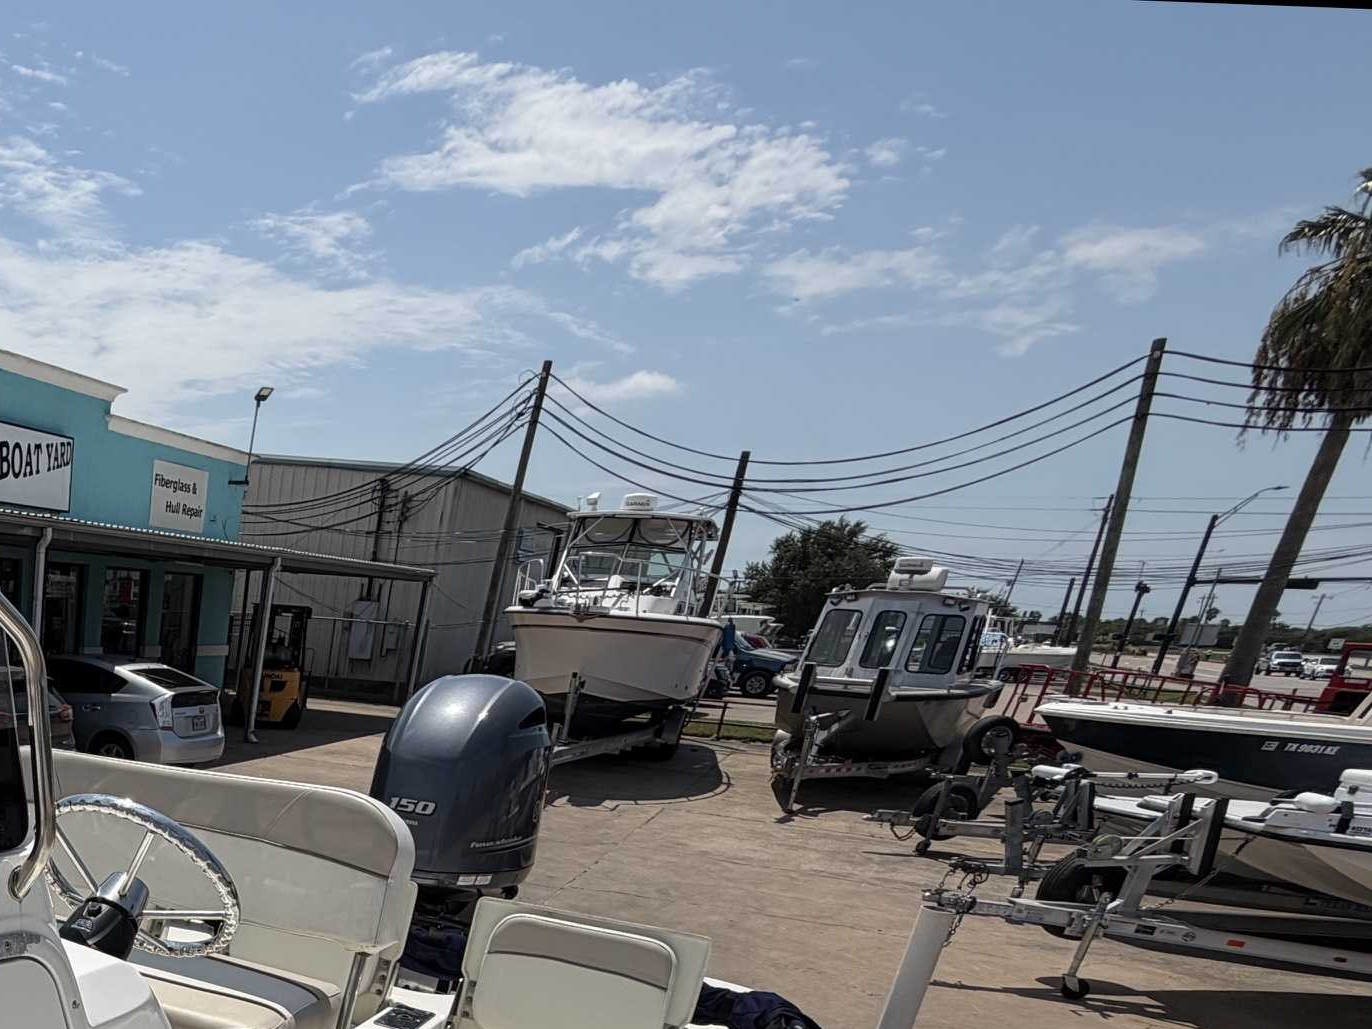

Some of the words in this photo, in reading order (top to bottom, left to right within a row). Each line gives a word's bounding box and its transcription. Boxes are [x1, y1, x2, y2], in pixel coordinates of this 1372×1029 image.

[46, 441, 72, 472] YARD
[154, 473, 191, 493] Fiberglass
[165, 500, 180, 514] Hull
[181, 503, 203, 519] Repair
[389, 796, 436, 815] 150
